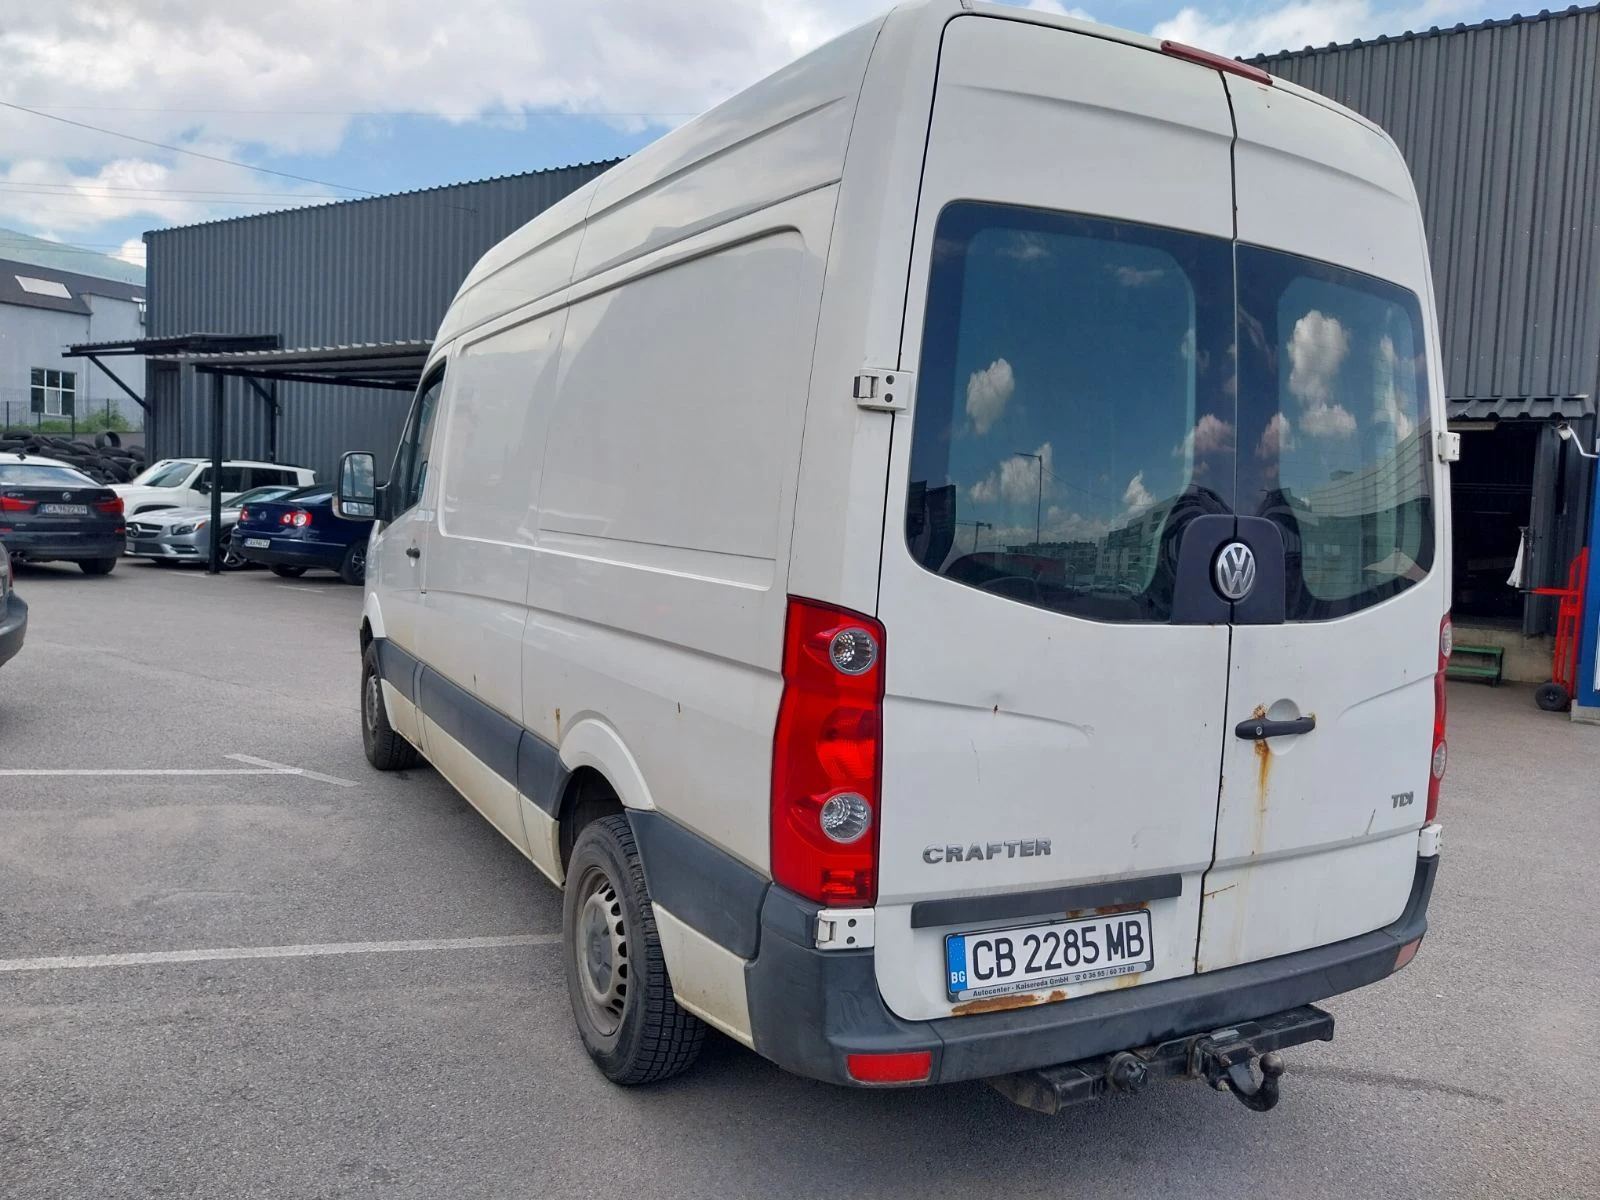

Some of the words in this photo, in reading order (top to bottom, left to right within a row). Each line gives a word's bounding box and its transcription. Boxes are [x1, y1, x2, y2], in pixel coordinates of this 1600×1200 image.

[1217, 542, 1256, 600] VW
[1391, 791, 1414, 809] TDI
[922, 838, 1052, 865] CRAFTER
[972, 937, 1017, 981] CB
[1022, 925, 1100, 975] 2285
[1105, 920, 1145, 962] MB
[951, 970, 966, 984] BG
[972, 986, 1010, 997] Autocenter
[1015, 980, 1048, 990] Kaiseroda
[1049, 976, 1069, 985] GmbH
